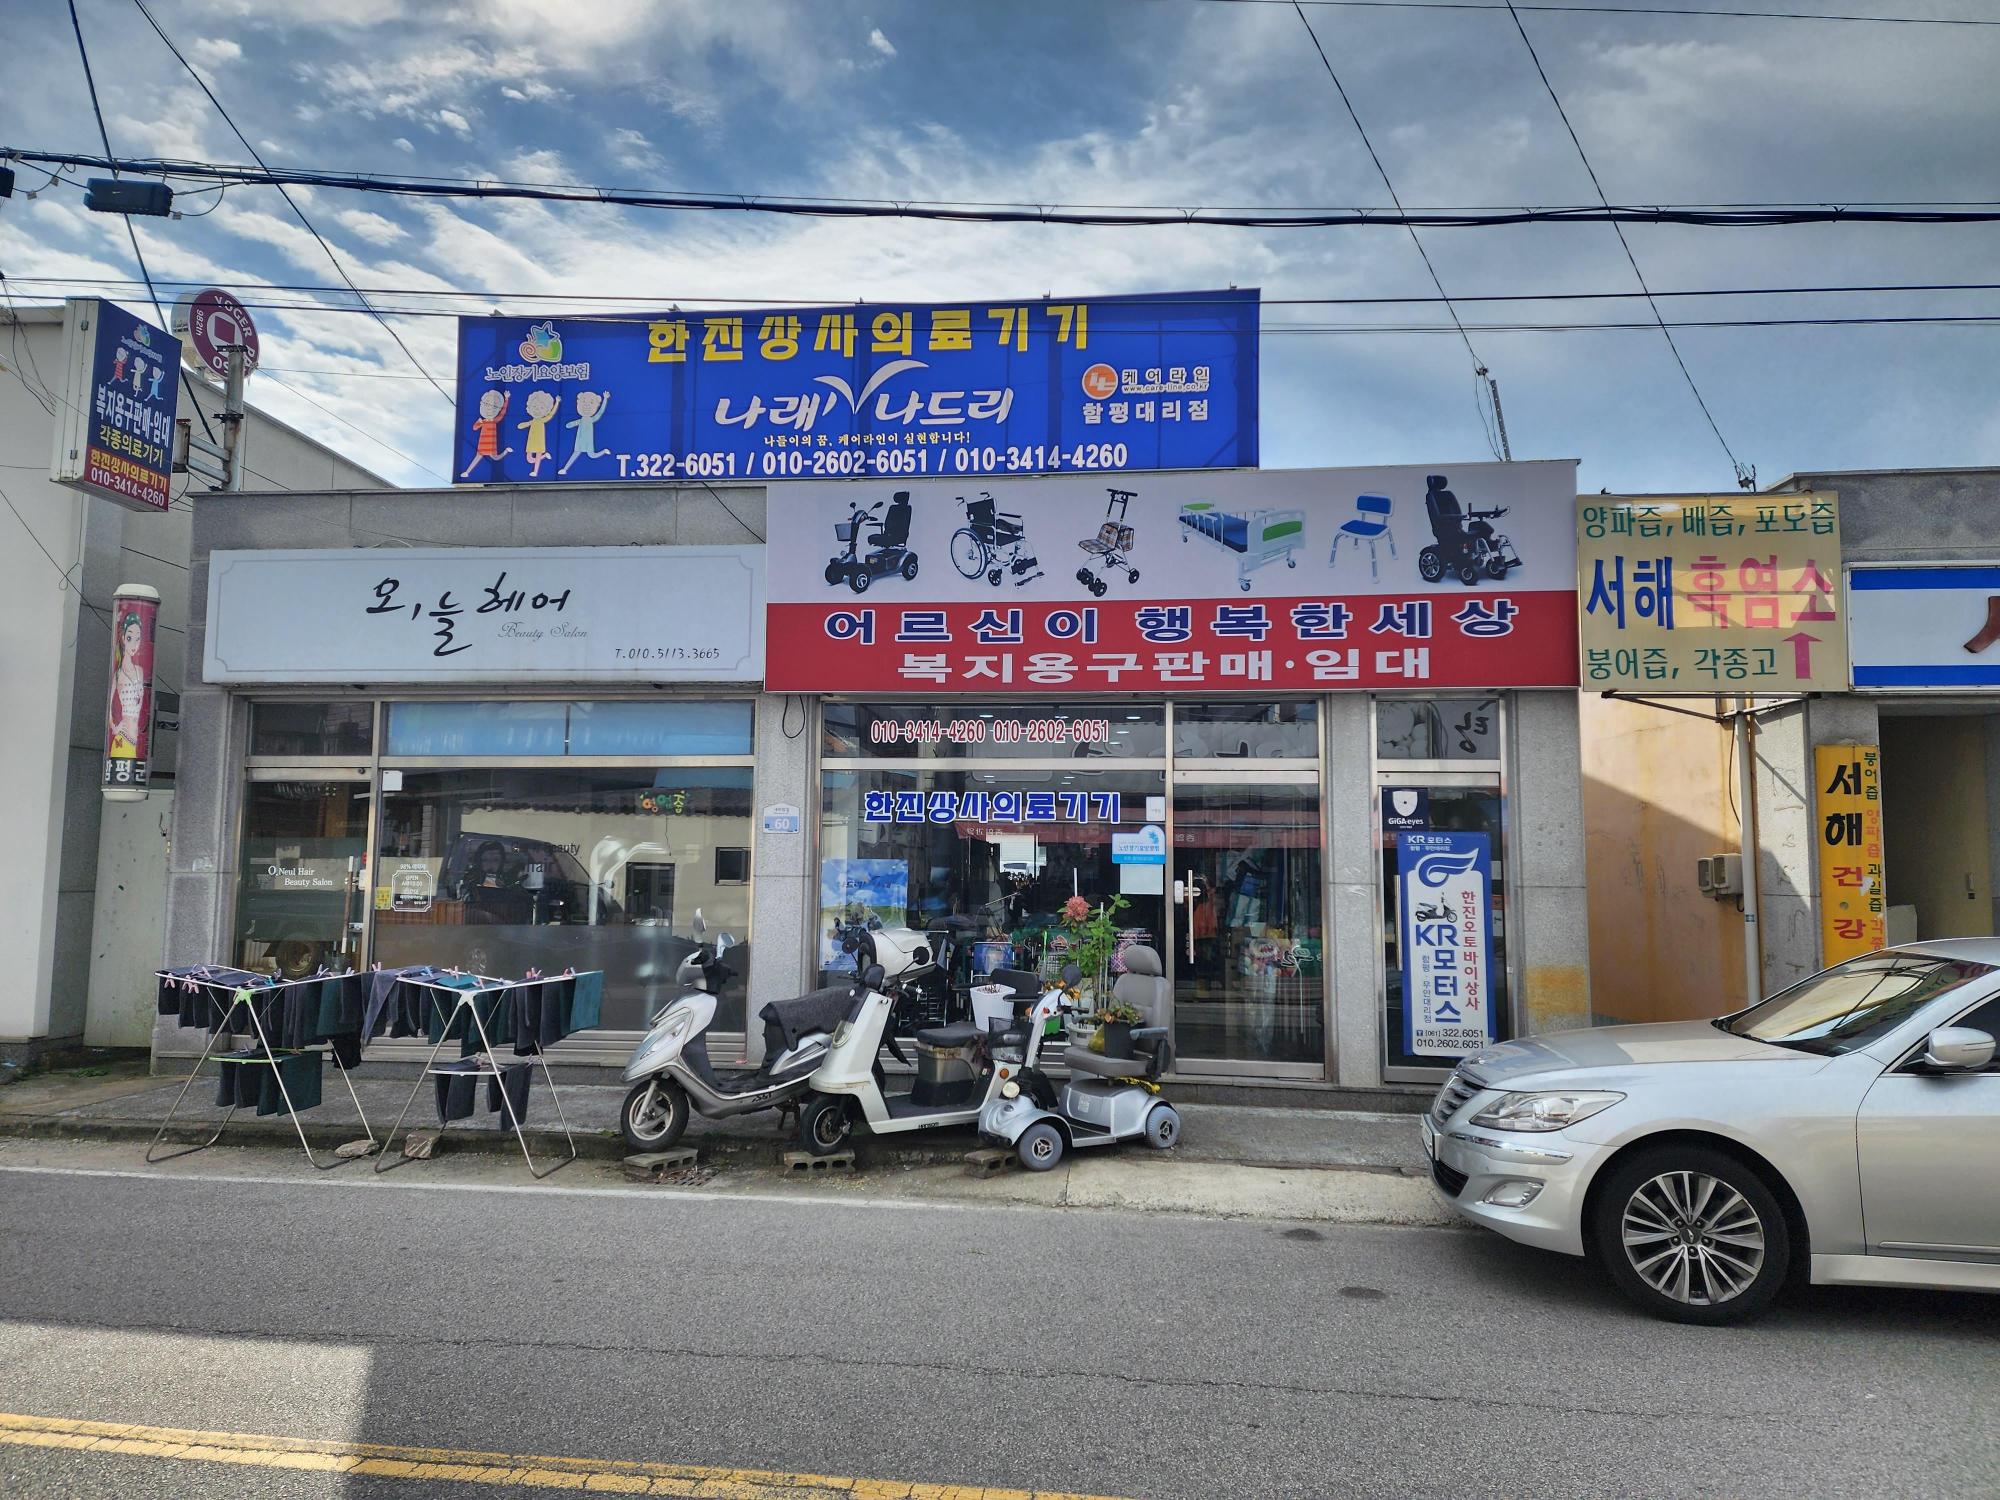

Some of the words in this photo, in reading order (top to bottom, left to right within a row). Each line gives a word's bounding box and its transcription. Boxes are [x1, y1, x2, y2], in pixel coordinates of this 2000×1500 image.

[647, 304, 1088, 363] 한진상사의료기기
[484, 363, 591, 383] 노인장기요양보험
[875, 387, 1014, 426] 나드리
[1082, 399, 1208, 425] 함평대리점
[99, 424, 164, 468] 각종의료기기
[763, 434, 812, 448] 나들이의
[838, 432, 899, 447] 케어라인이
[903, 431, 971, 445] 실현합니다!
[90, 448, 168, 493] 한진상사의료기기
[616, 452, 736, 478] T.322-6051
[762, 447, 928, 475] 010-2602-6051
[954, 443, 1128, 473] 010-3414-4260
[91, 467, 165, 507] 010-3414-4260
[1682, 505, 1746, 537] 배즙,
[1585, 555, 1675, 630] 서해
[1686, 554, 1836, 630] 흑염소
[497, 621, 545, 643] Beauty
[549, 621, 588, 638] Salon
[824, 606, 1099, 646] 어르신이
[1587, 648, 1680, 681] 붕어즙,
[1694, 648, 1779, 680] 각종고
[870, 719, 986, 744] 010-3414-4260
[993, 719, 1110, 744] 010-2602-6051
[1863, 752, 1878, 801] 붕어즙
[774, 818, 790, 829] 60
[863, 790, 1122, 825] 한진상사의료기기
[1407, 835, 1426, 844] KR
[1427, 836, 1453, 844] 모터스
[1865, 809, 1881, 859] 양파즙
[284, 878, 310, 887] Beauty
[312, 878, 333, 886] Salon
[298, 868, 315, 876] Hair
[1415, 924, 1461, 947] KR
[1461, 890, 1481, 1011] 한진오토바이상사
[1433, 949, 1462, 1024] 모터스
[1416, 1039, 1485, 1049] 010.2602.6051
[1442, 1028, 1484, 1039] 322.6051
